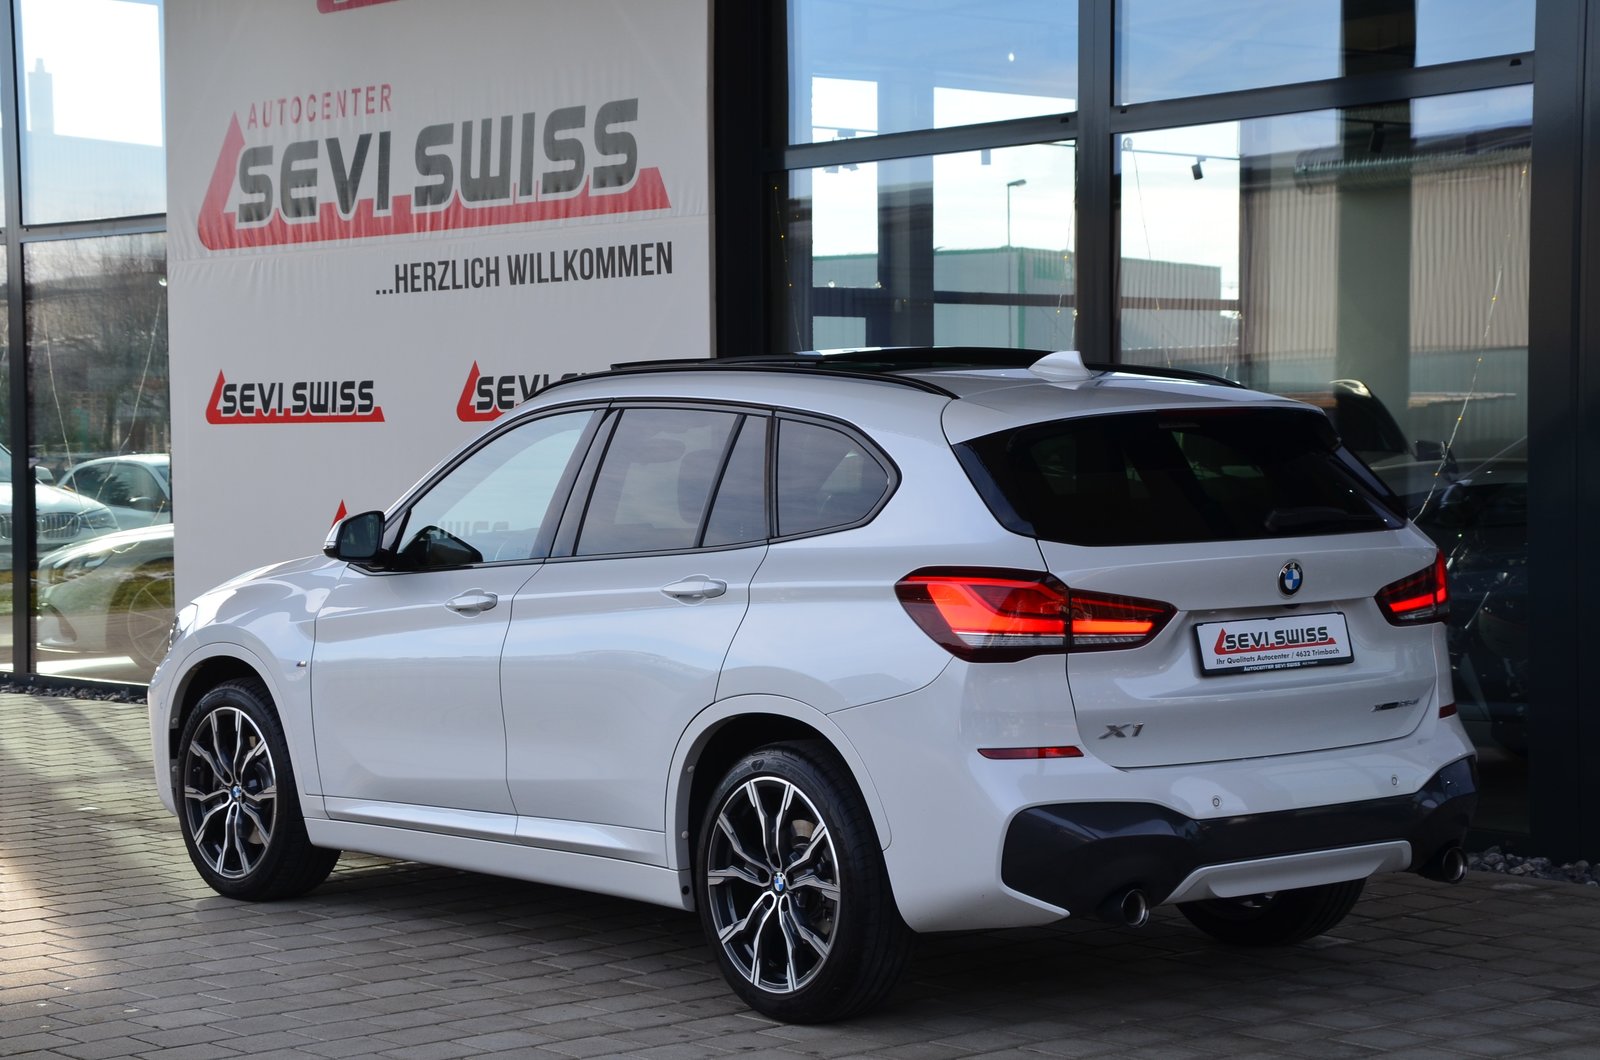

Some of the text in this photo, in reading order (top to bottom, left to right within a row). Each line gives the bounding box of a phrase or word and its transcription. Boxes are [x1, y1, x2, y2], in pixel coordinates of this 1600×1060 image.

[246, 84, 392, 130] AUTOCENTER
[238, 97, 639, 223] SEVI SWISS
[375, 241, 673, 295] ...HERZLICH WILLKOMMEN
[222, 380, 374, 415] SEVI SWISS
[1226, 627, 1328, 649] SEVI SWISS
[1257, 652, 1290, 662] Autocenter
[1295, 650, 1311, 658] 4632
[1312, 648, 1340, 657] Trimbach
[1098, 723, 1144, 739] X1
